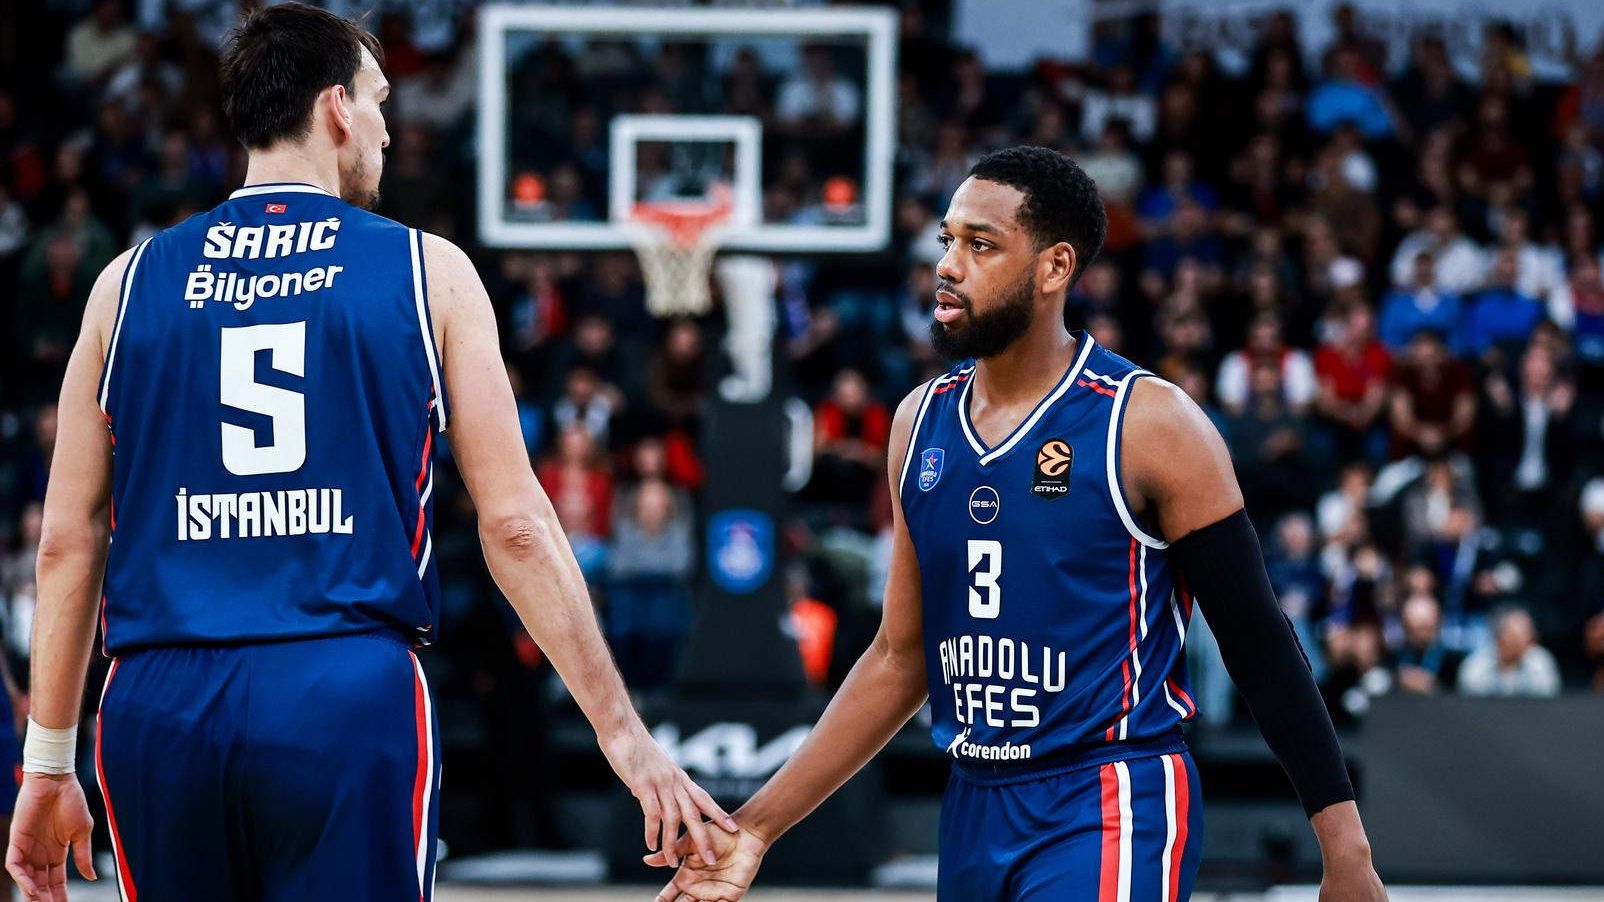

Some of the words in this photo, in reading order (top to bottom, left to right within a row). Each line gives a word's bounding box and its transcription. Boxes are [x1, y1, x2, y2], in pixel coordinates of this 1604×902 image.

[203, 217, 341, 259] ŠARIĆ
[184, 264, 343, 311] Bilyoner
[220, 320, 307, 476] 5
[971, 500, 998, 508] GSA
[1034, 485, 1068, 493] ETIHAD
[175, 487, 354, 541] İSTANBUL
[967, 539, 1002, 619] 3
[939, 635, 1066, 693] ANADOLU
[953, 683, 1040, 728] EFES
[960, 741, 1031, 760] corendon
